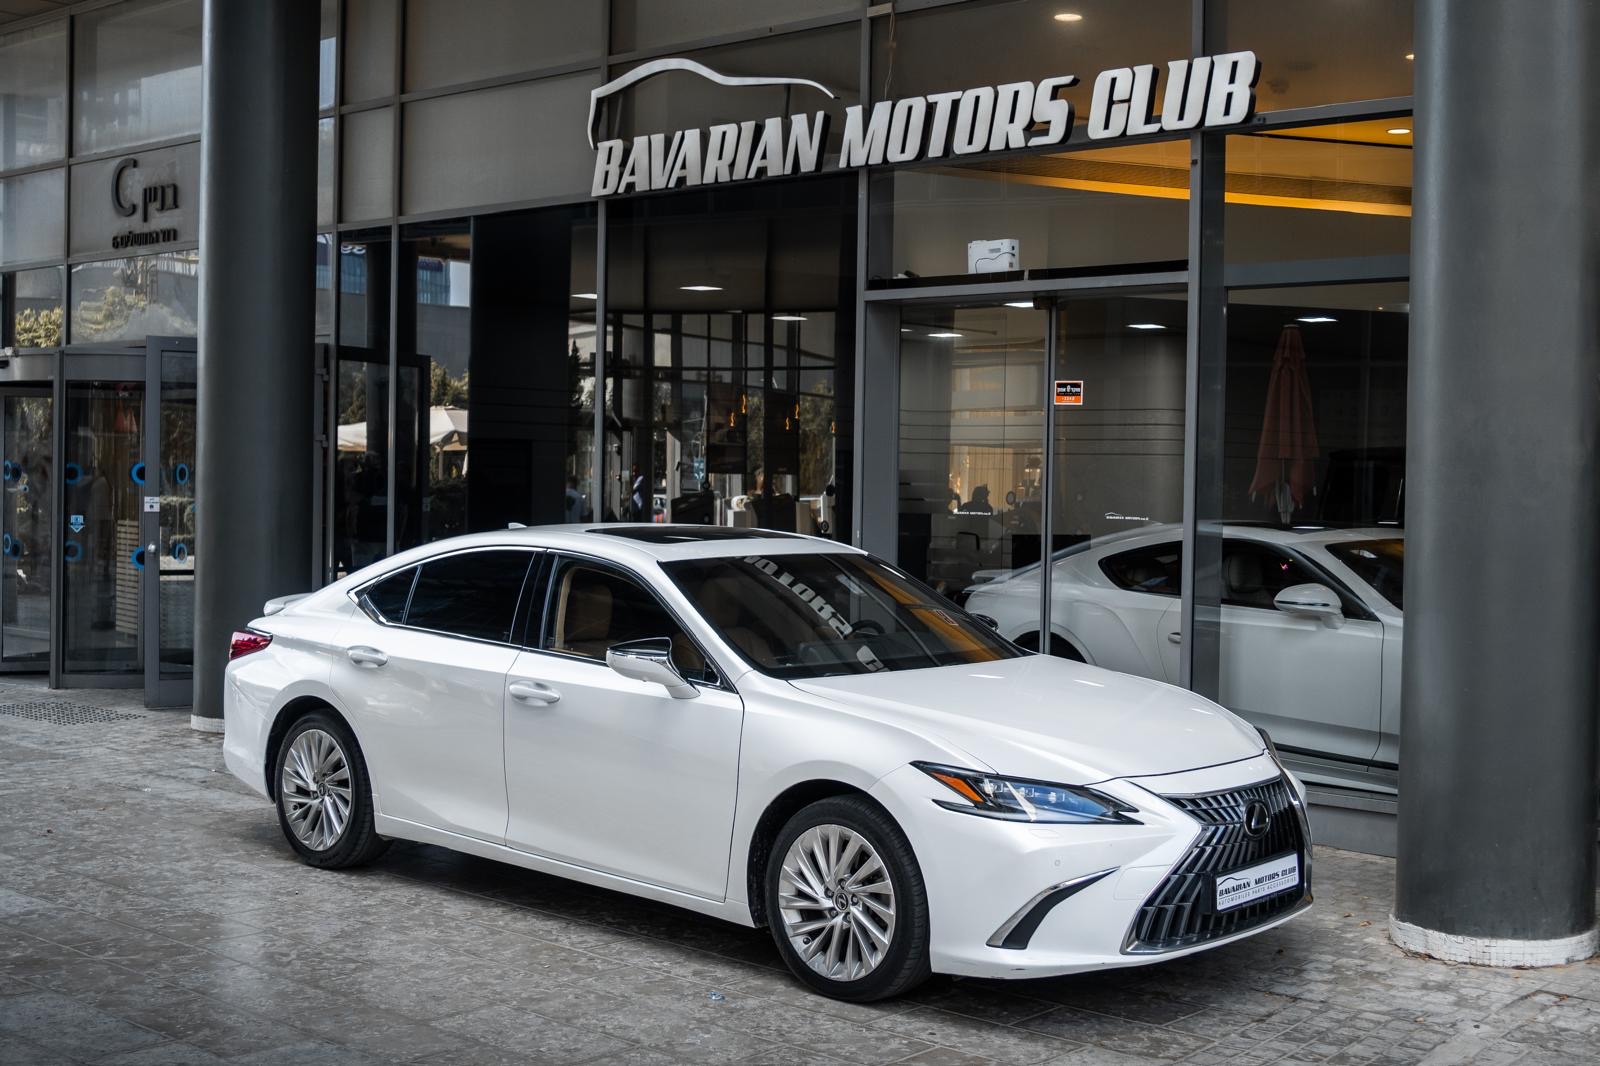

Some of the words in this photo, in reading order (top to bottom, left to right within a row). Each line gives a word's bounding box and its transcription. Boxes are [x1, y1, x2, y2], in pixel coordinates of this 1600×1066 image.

[591, 110, 827, 198] BAVARIAN
[838, 74, 1077, 169] MOTORS
[1087, 50, 1258, 140] CLUB
[111, 157, 138, 218] C
[143, 183, 179, 223] בניין
[1219, 881, 1251, 896] BAVARIAN
[1254, 872, 1280, 885] MOTORS
[1281, 866, 1297, 876] CLUB
